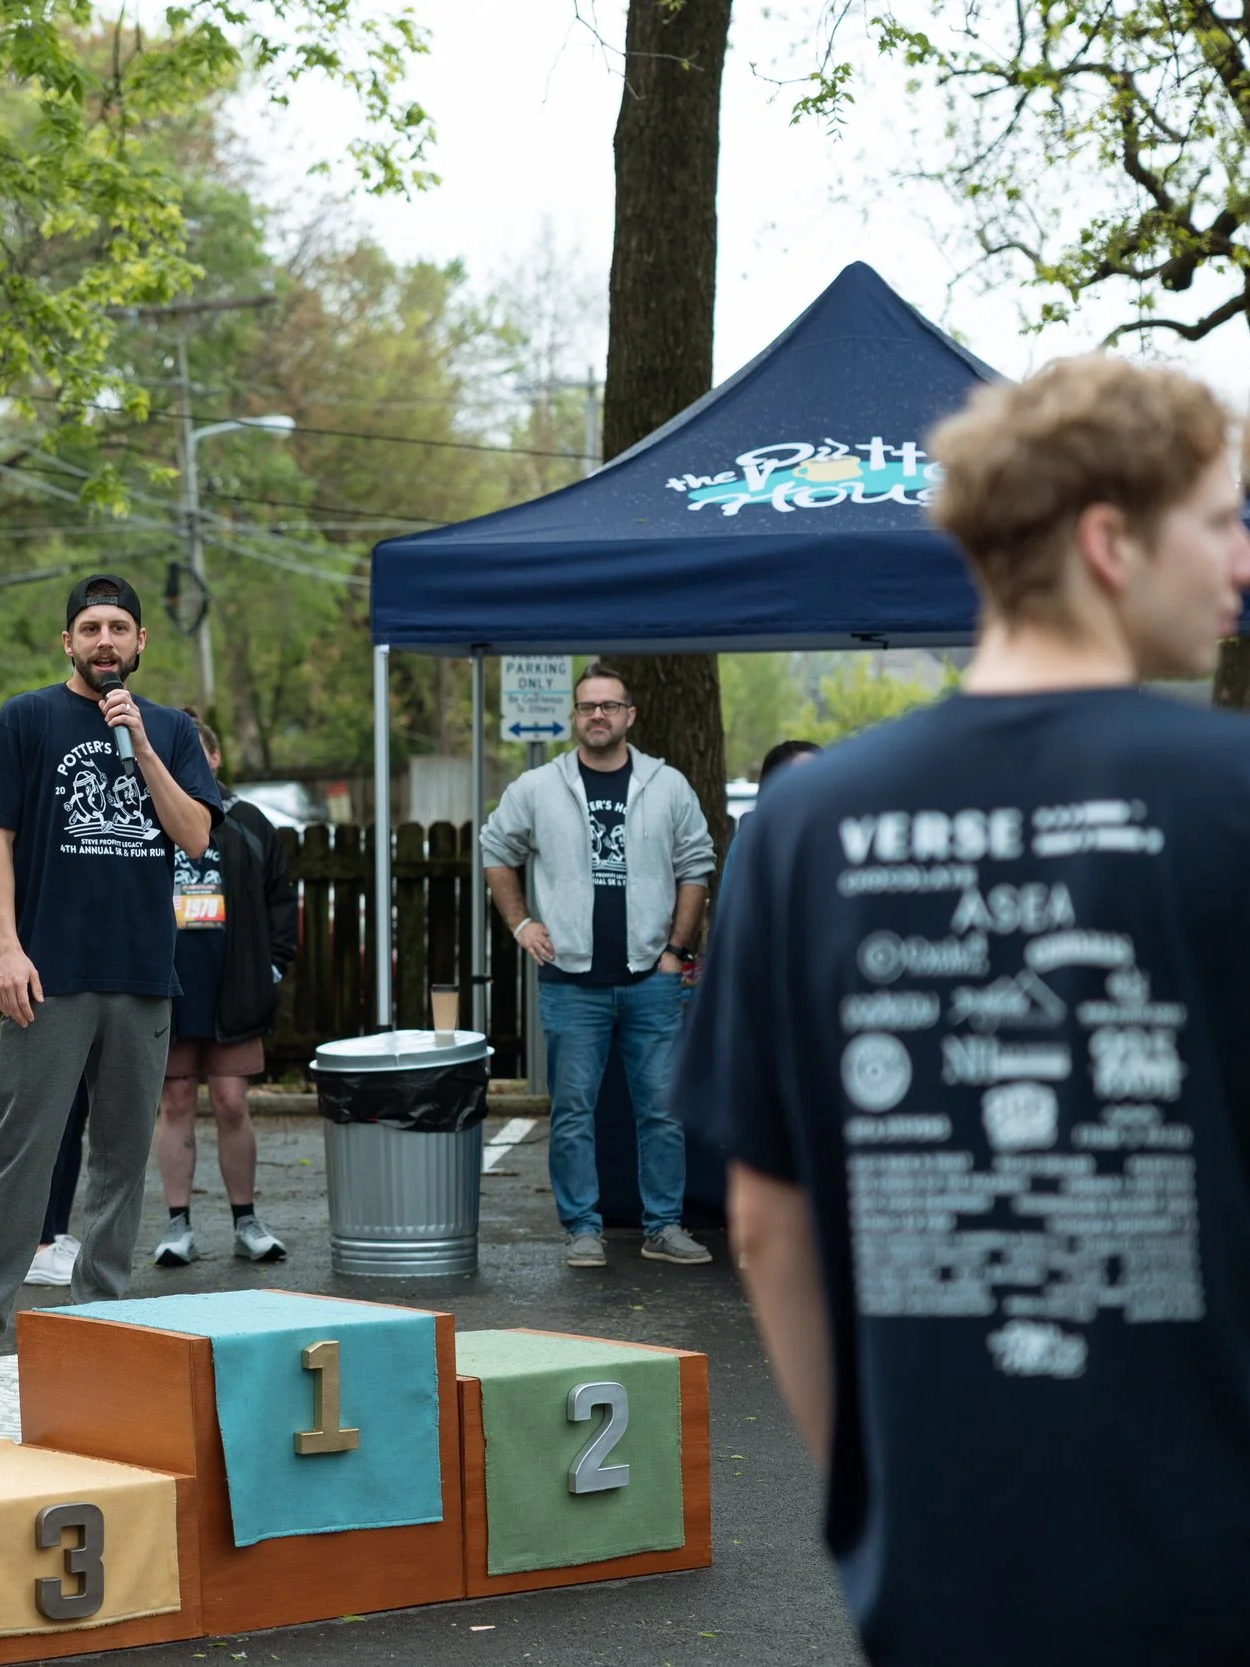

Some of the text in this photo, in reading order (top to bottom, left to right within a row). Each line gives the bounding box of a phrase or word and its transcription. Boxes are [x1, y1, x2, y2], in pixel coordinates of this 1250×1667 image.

[665, 470, 738, 492] the
[687, 481, 936, 516] Hou
[506, 662, 566, 675] PARKING
[518, 677, 554, 690] ONLY
[57, 740, 112, 776] POTTER'S
[55, 786, 66, 795] 20
[589, 800, 612, 812] ER'S
[839, 807, 1024, 863] VERSE
[60, 844, 76, 853] 4TH
[79, 846, 114, 855] ANNUAL
[123, 849, 129, 857] &
[130, 848, 147, 857] FUN
[149, 848, 165, 857] RUN
[293, 1340, 359, 1456] 1
[567, 1381, 630, 1494] 2
[35, 1502, 104, 1619] 3
